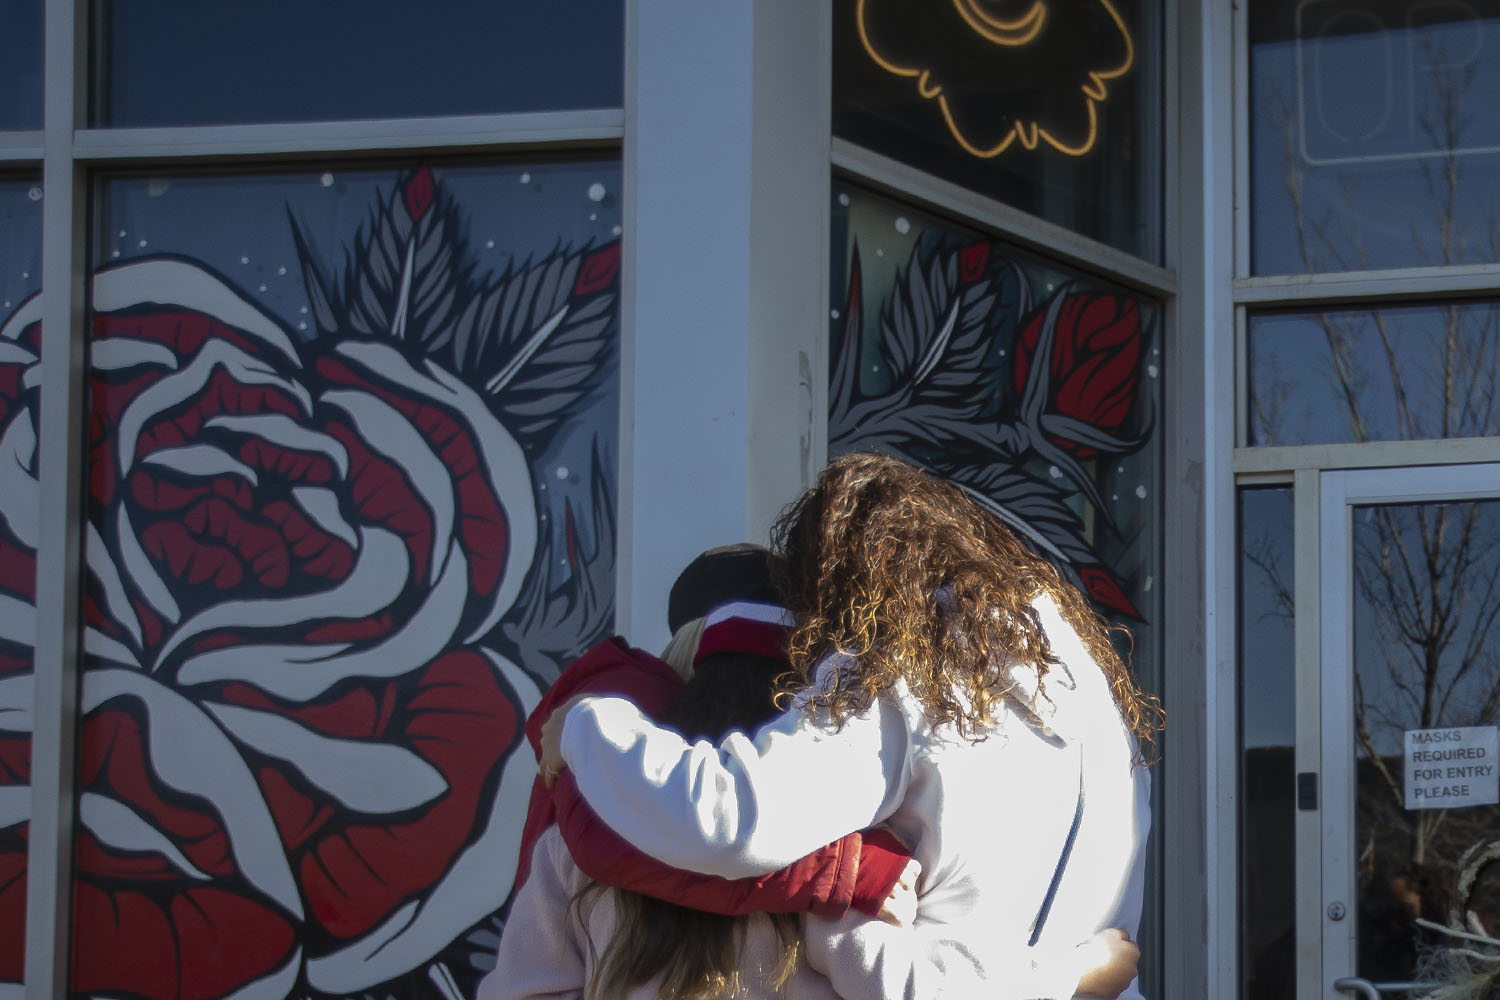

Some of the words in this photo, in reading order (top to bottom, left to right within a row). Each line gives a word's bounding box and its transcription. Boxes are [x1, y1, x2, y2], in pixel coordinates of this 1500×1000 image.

[1412, 731, 1462, 744] MASKS
[1413, 747, 1486, 762] REQUIRED
[1414, 768, 1442, 781] FOR
[1447, 765, 1493, 778] ENTRY
[1415, 785, 1470, 799] PLEASE
